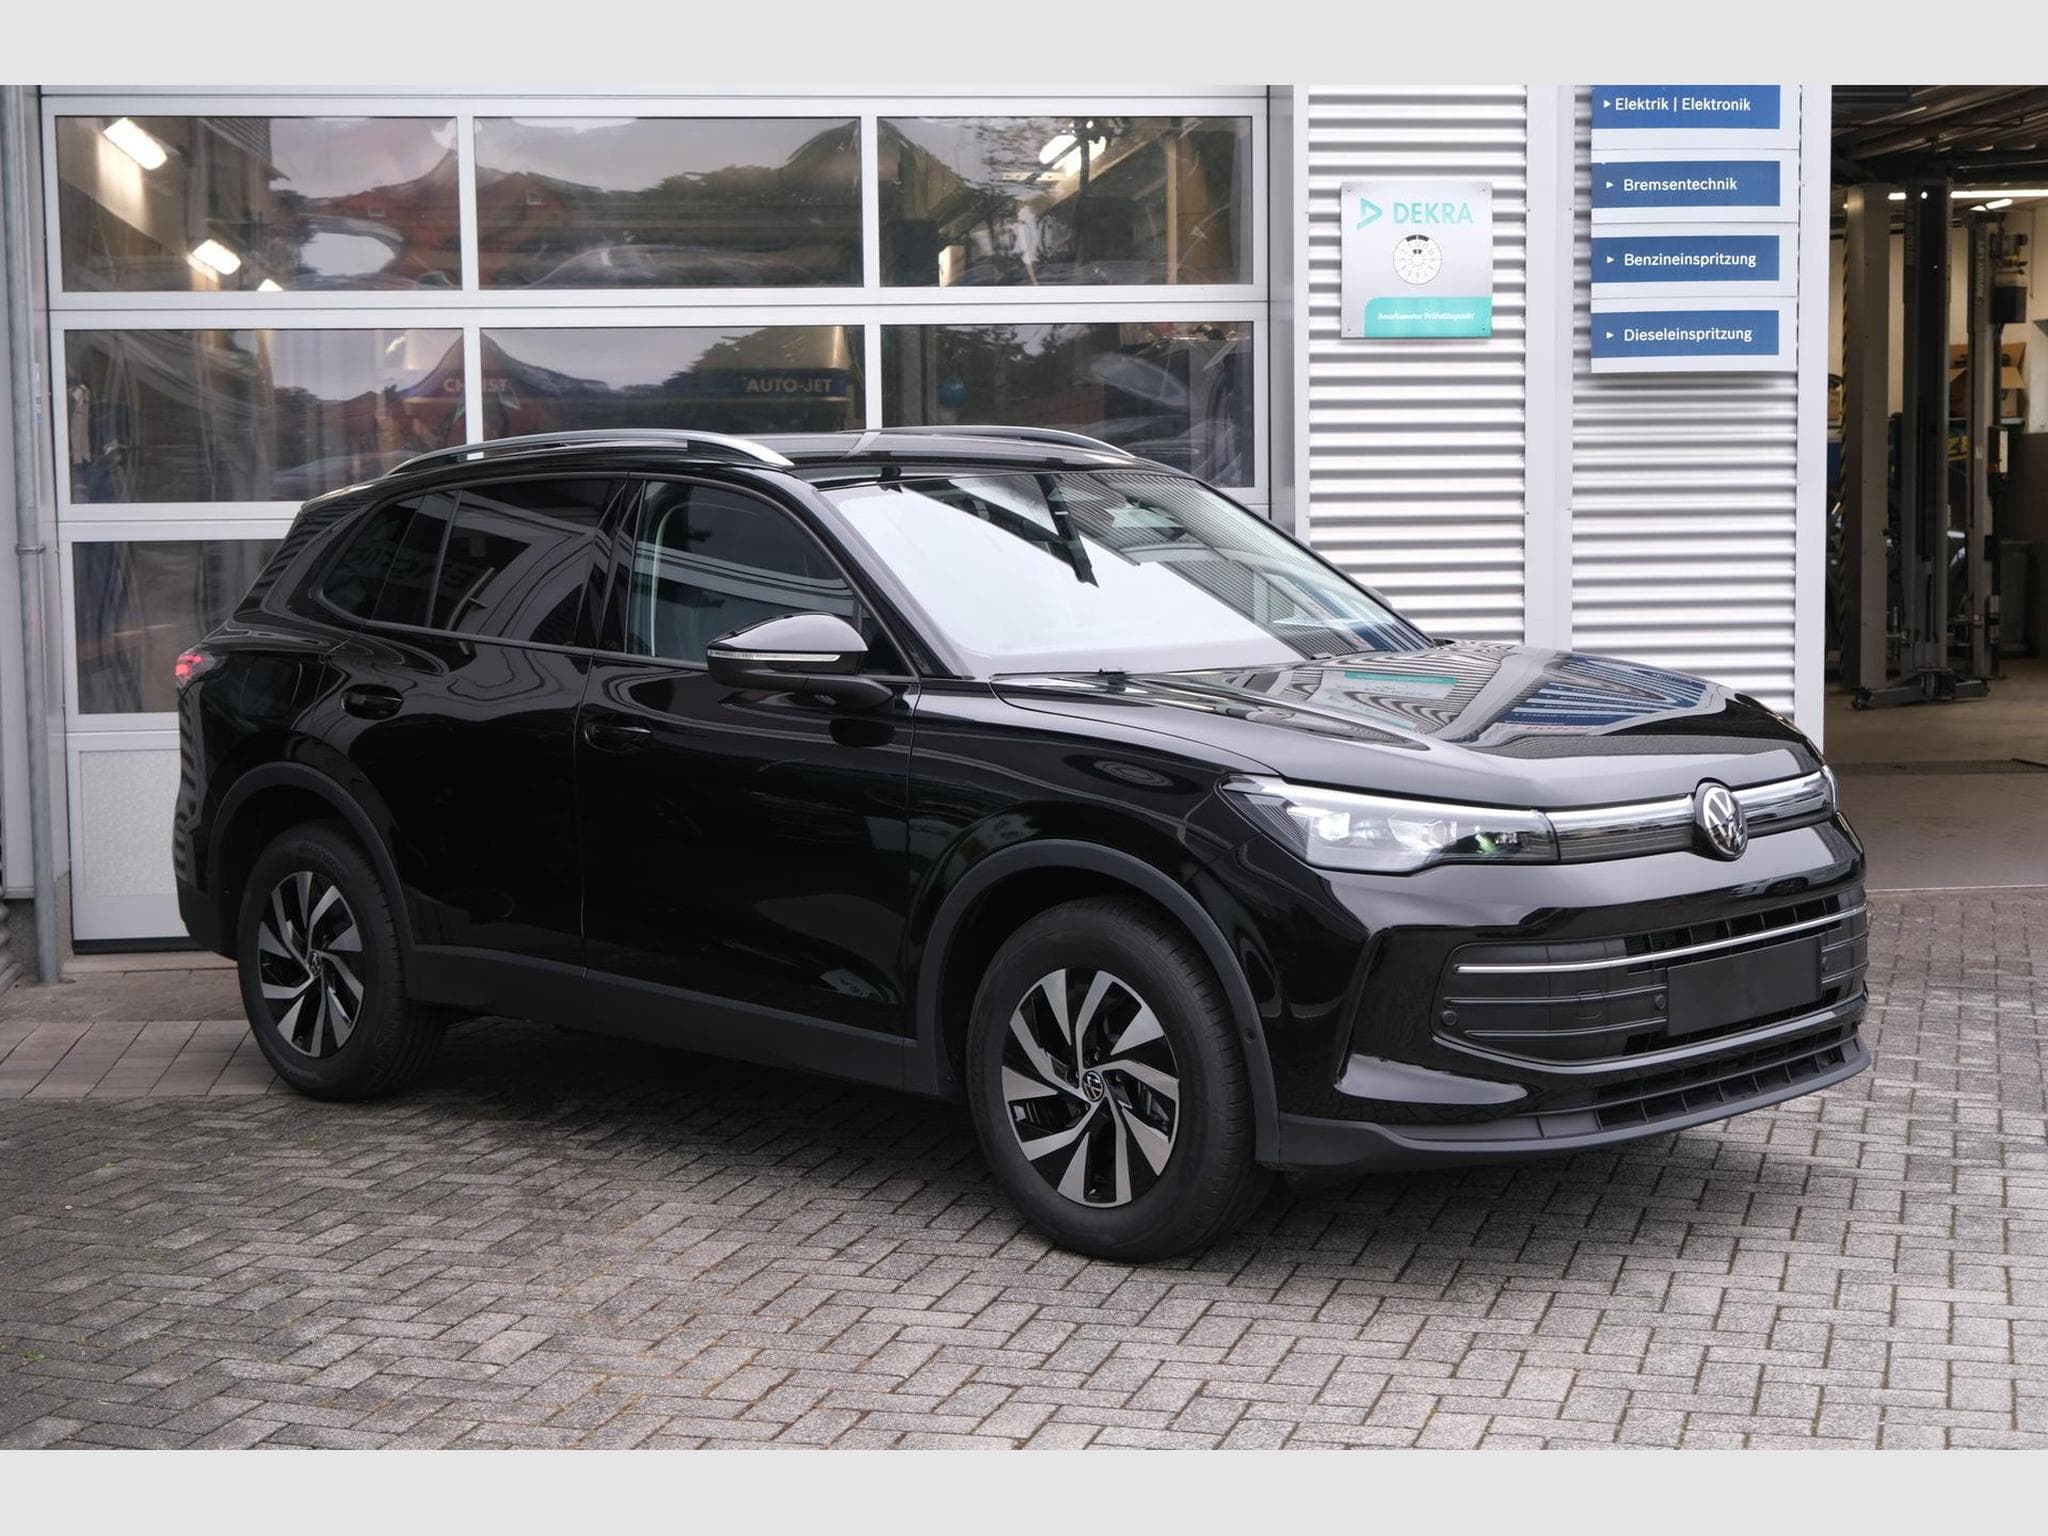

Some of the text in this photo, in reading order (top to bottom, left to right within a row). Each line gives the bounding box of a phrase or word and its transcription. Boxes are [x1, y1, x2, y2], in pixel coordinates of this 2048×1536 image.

[1615, 97, 1669, 111] Elektrik
[1681, 97, 1751, 112] Elektronik
[1623, 177, 1738, 191] Bremsentechnik
[1392, 201, 1474, 225] DEKRA
[1624, 252, 1757, 268] Benzineinspritzung
[1624, 328, 1753, 343] Dieseleinspritzung
[443, 378, 509, 393] CHIST
[747, 378, 832, 393] AUTO-JET
[1703, 786, 1747, 856] VW
